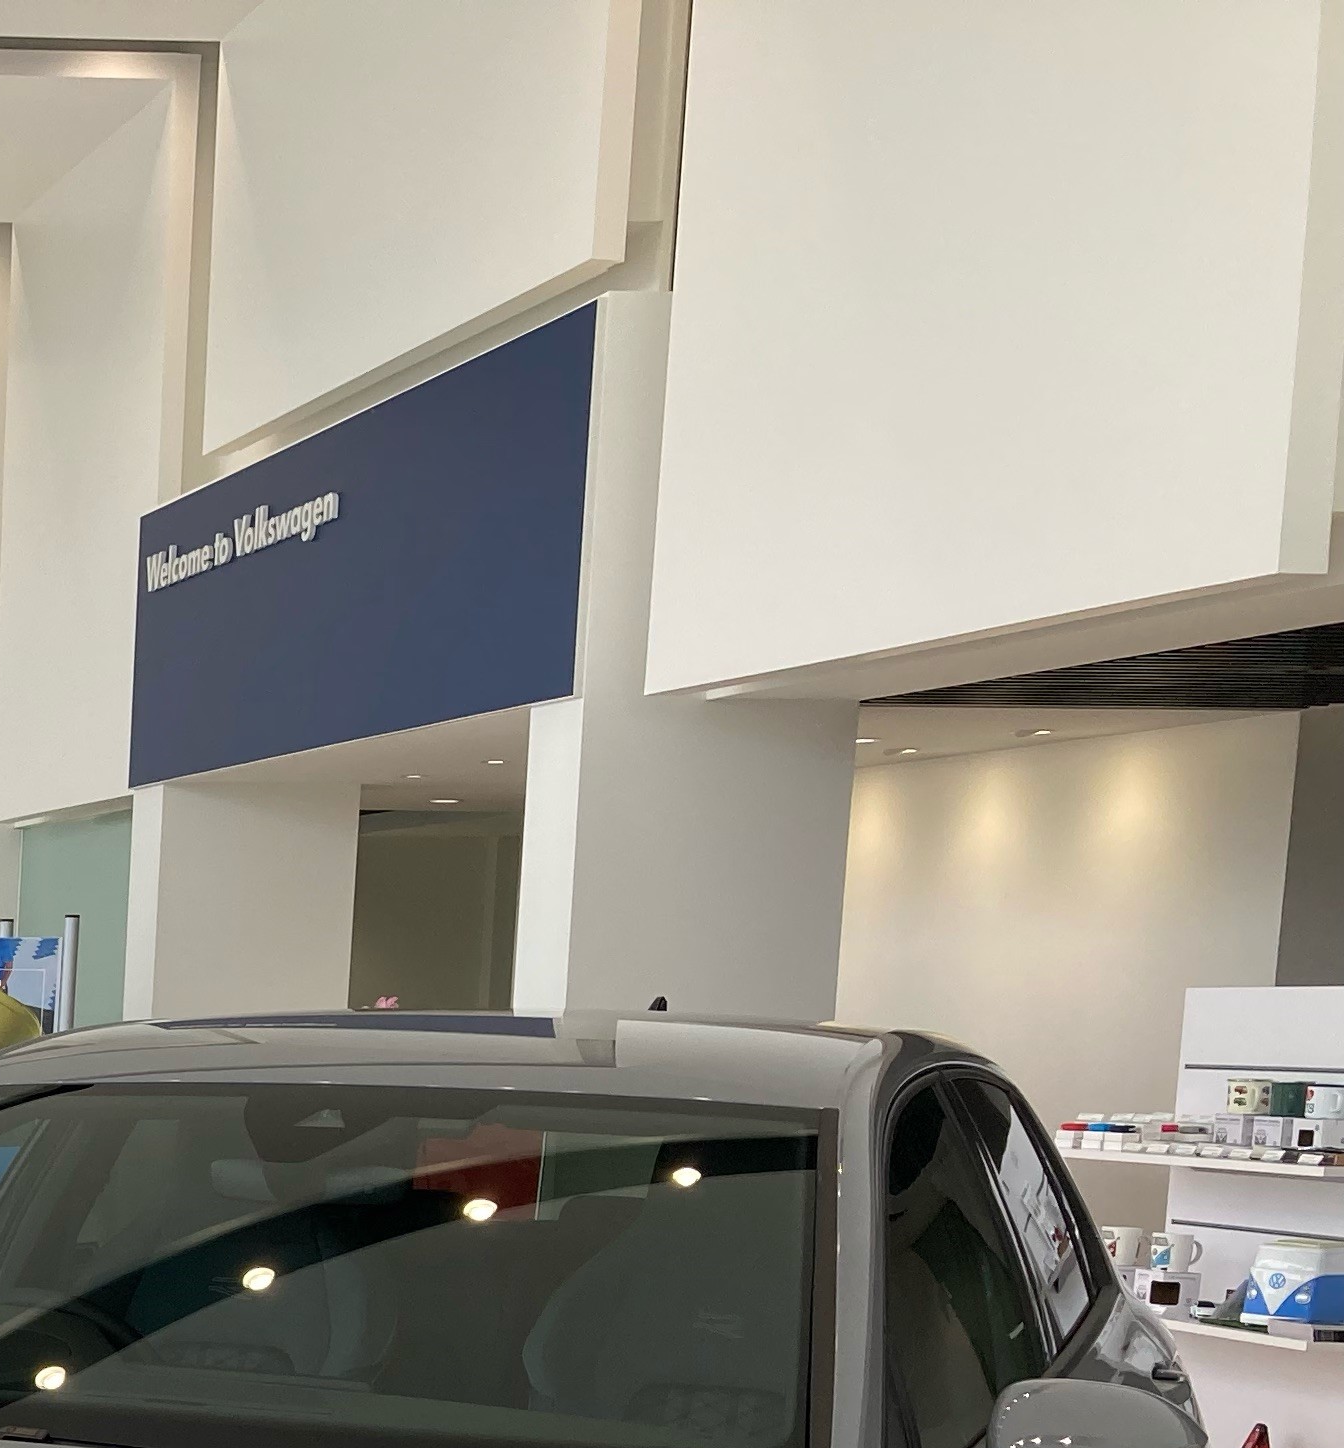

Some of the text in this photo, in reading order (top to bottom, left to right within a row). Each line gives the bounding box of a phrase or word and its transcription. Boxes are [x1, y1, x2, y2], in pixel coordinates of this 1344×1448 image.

[147, 491, 340, 592] Welcome to Volkswagen
